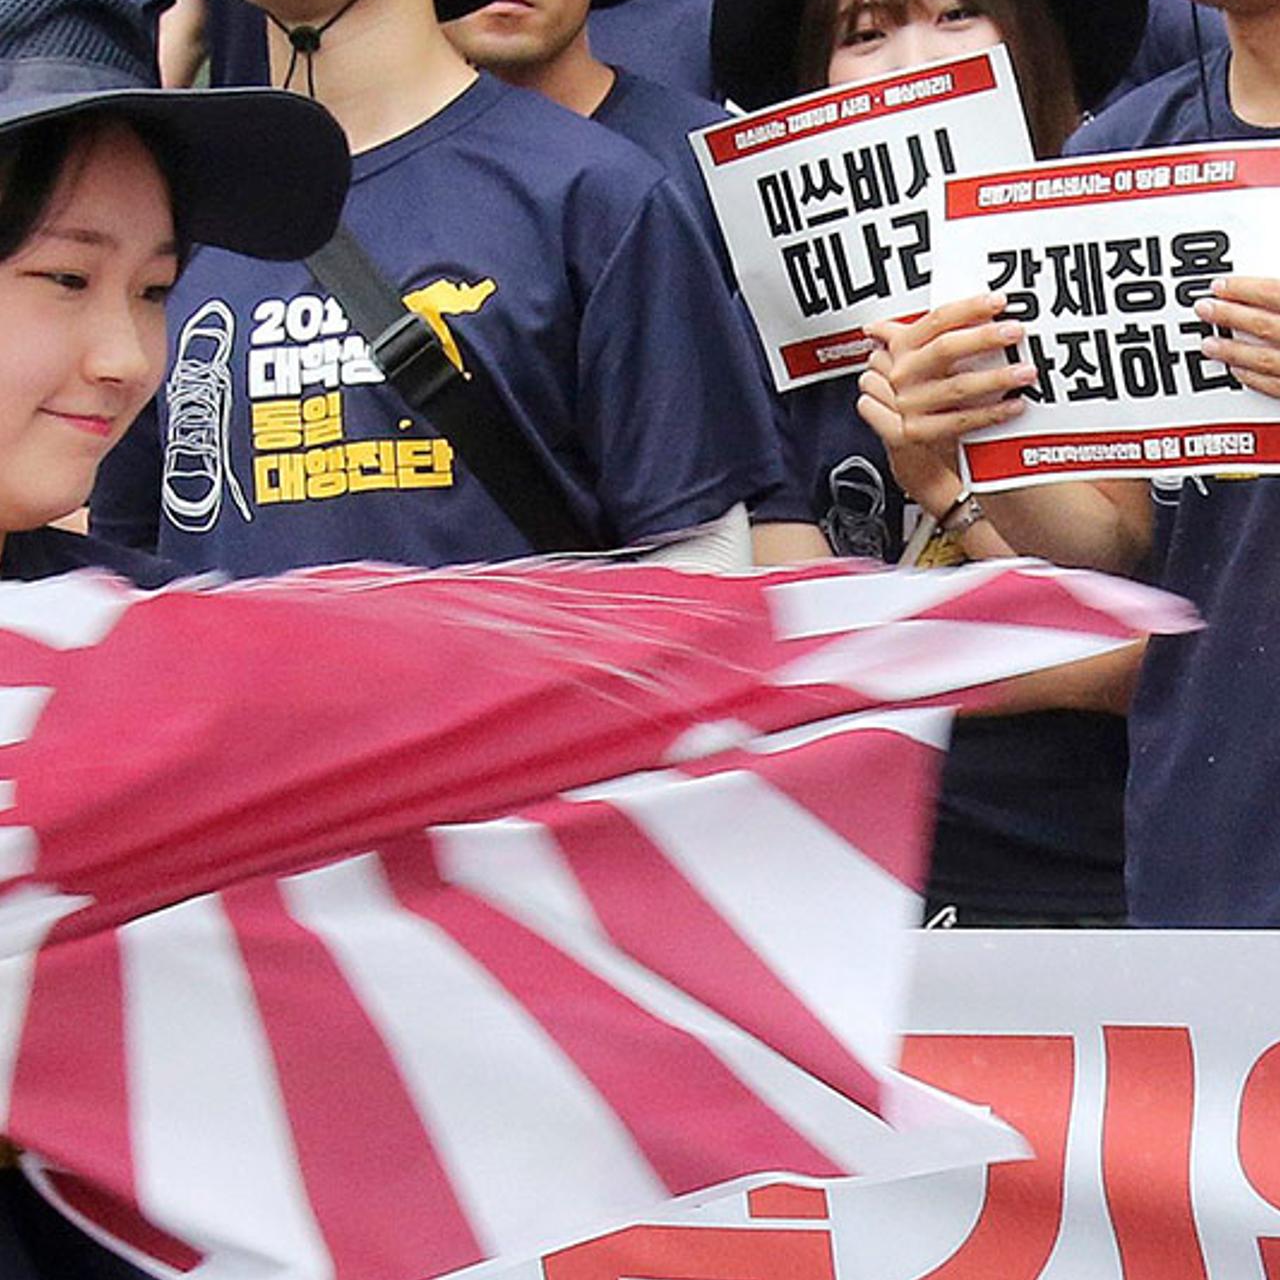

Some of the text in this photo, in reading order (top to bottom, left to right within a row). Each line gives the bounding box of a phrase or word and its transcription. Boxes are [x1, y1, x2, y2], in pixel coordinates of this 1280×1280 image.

[757, 128, 957, 239] 미쓰비시
[1114, 170, 1132, 192] 이
[987, 230, 1234, 322] 강제징용
[249, 335, 387, 400] 대학생
[252, 391, 343, 451] 통일
[253, 438, 454, 505] 대행진단
